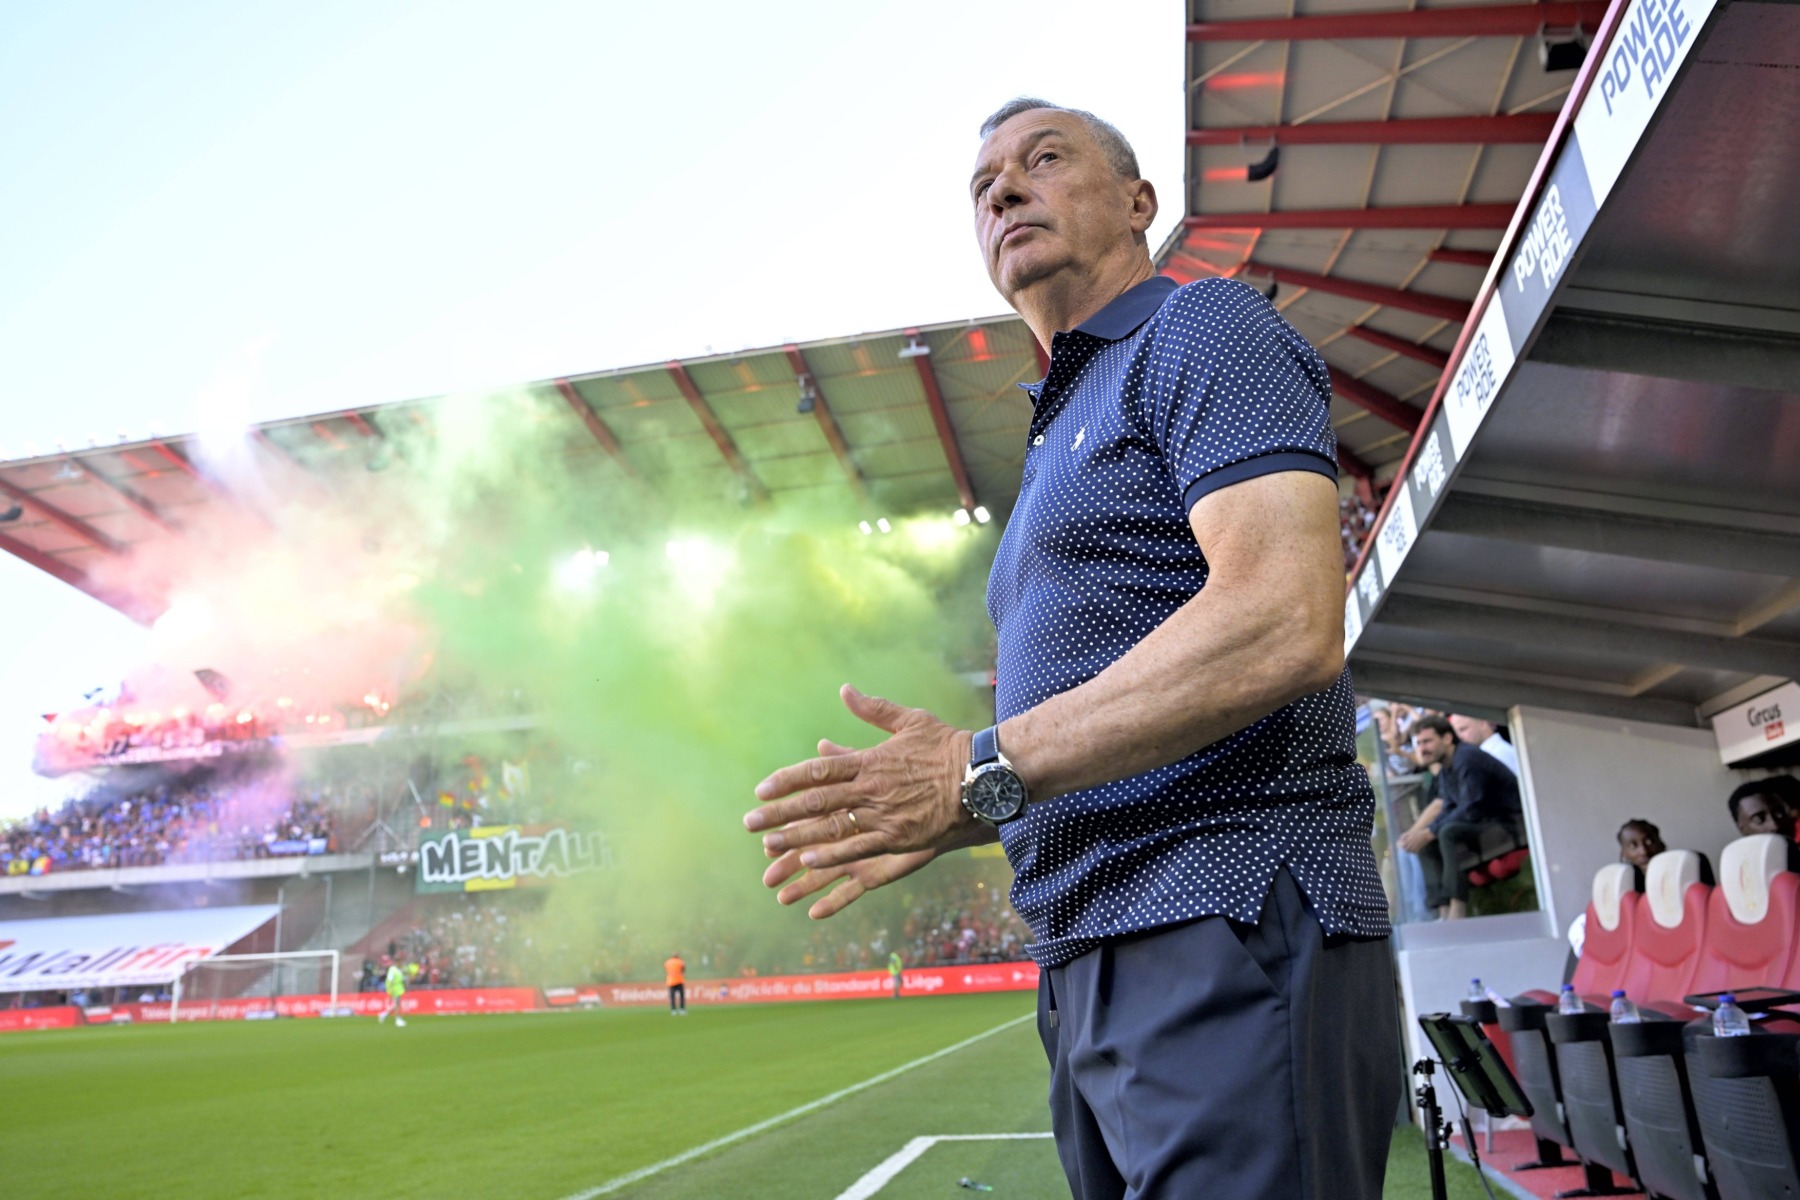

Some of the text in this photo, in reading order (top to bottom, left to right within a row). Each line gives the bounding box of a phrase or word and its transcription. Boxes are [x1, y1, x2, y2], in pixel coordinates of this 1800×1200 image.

[1601, 0, 1668, 117] POWE
[1641, 0, 1691, 100] ADE
[1513, 184, 1563, 293] POWER
[1540, 214, 1573, 289] ADE
[1456, 331, 1490, 408] POWER
[1475, 358, 1497, 410] ADE
[1747, 703, 1782, 728] Circus
[814, 975, 880, 992] Standard
[903, 974, 944, 991] Liège
